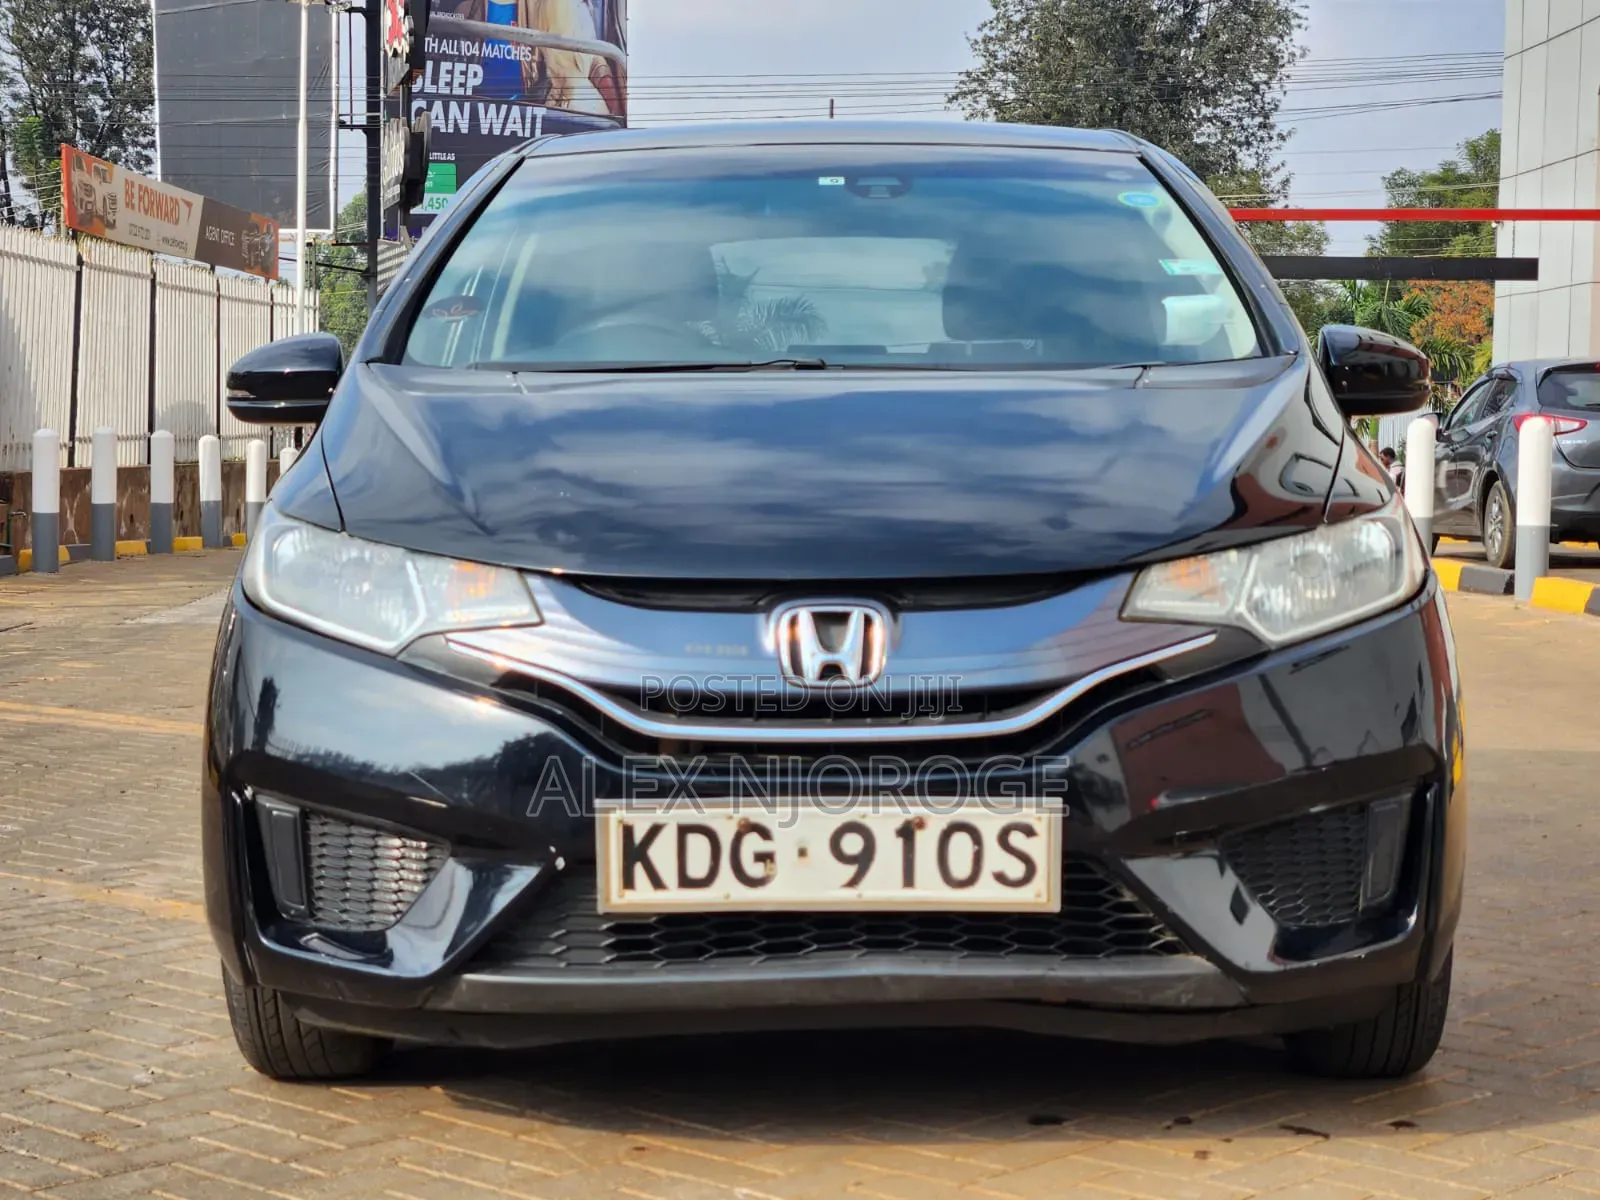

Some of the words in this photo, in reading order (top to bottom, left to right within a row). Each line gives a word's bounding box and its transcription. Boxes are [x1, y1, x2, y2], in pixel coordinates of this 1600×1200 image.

[439, 40, 459, 56] ALL
[461, 41, 480, 57] 104
[481, 42, 532, 62] MATCHES
[411, 98, 471, 134] CAN
[477, 102, 548, 138] WAIT
[124, 177, 135, 209] BE
[138, 183, 181, 226] FORWARD
[205, 225, 220, 242] AGENT
[220, 229, 235, 246] OFFICE
[621, 821, 777, 891] KDG
[829, 820, 1038, 890] 910S
